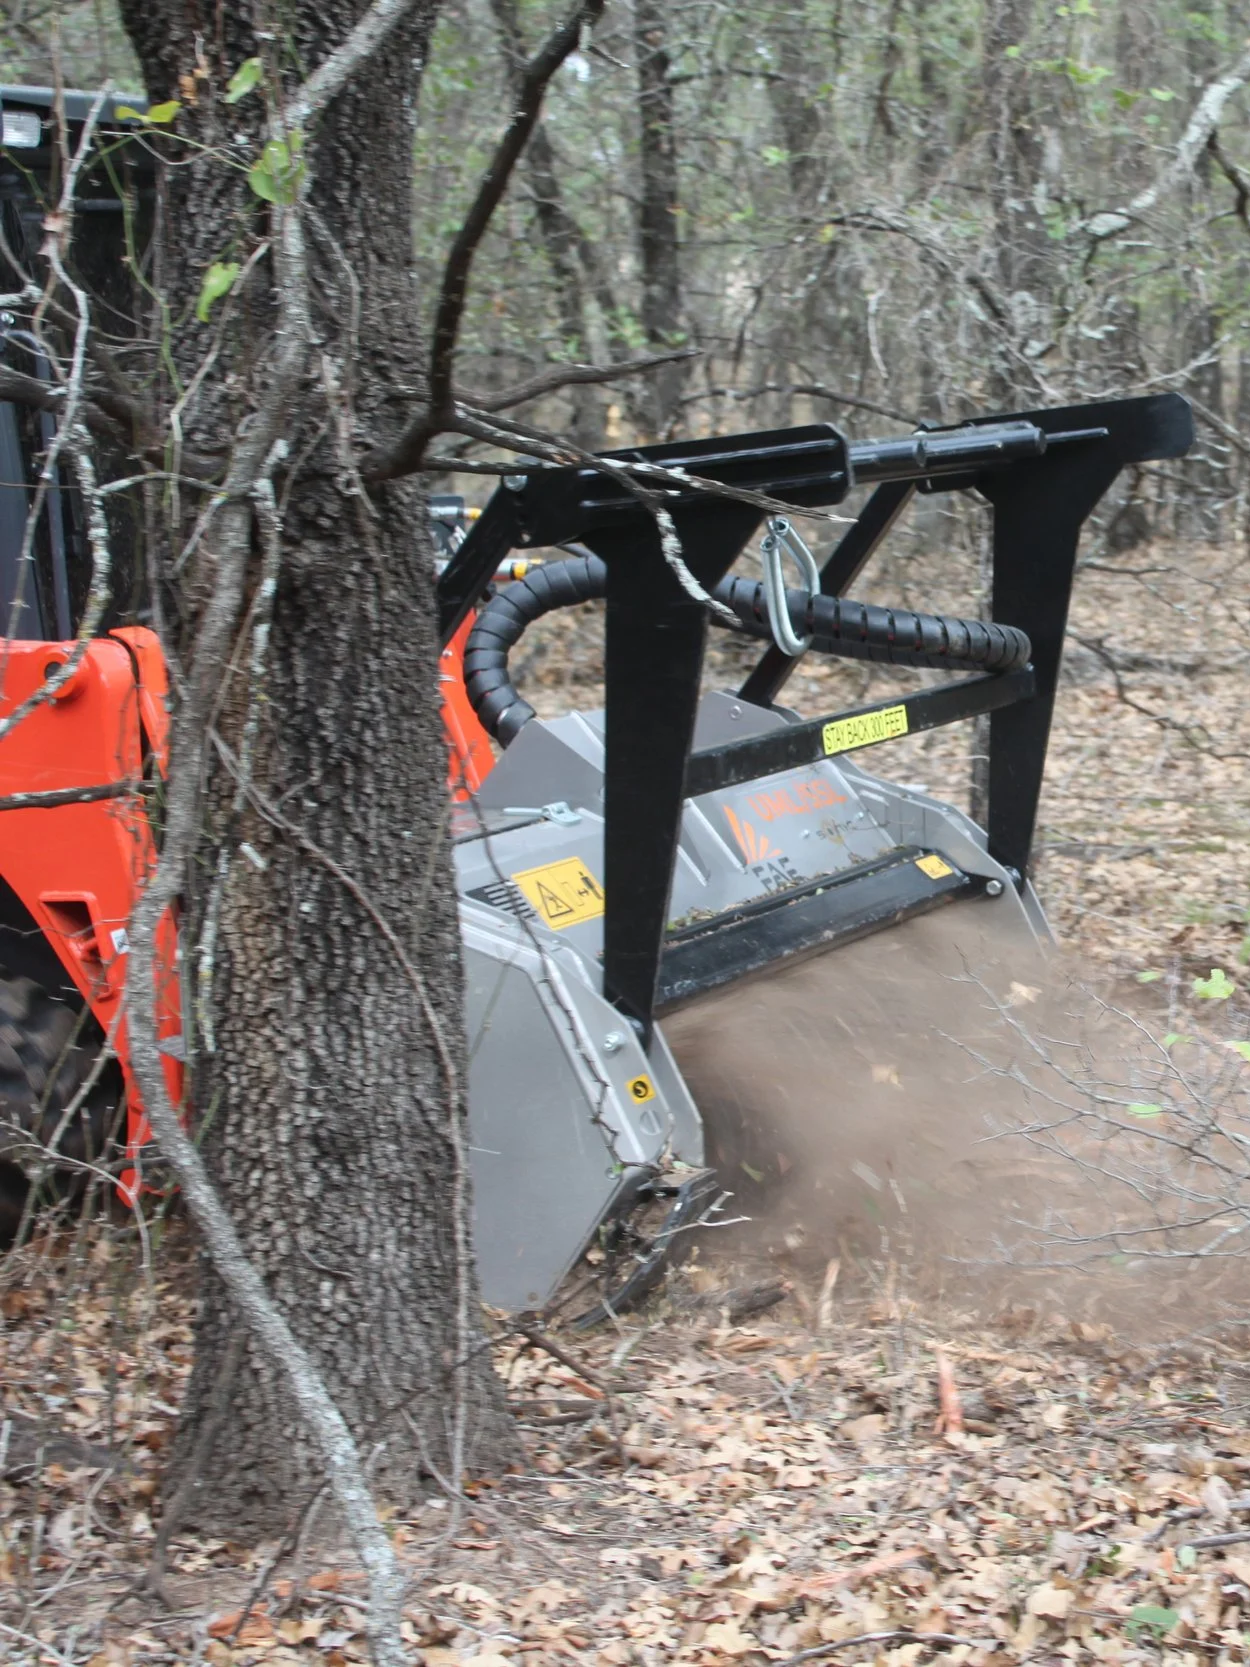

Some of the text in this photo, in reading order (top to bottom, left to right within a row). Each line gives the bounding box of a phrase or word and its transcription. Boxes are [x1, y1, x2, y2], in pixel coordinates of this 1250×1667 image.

[825, 725, 846, 750] STAY
[847, 718, 870, 744] BACK
[884, 709, 906, 735] FEET
